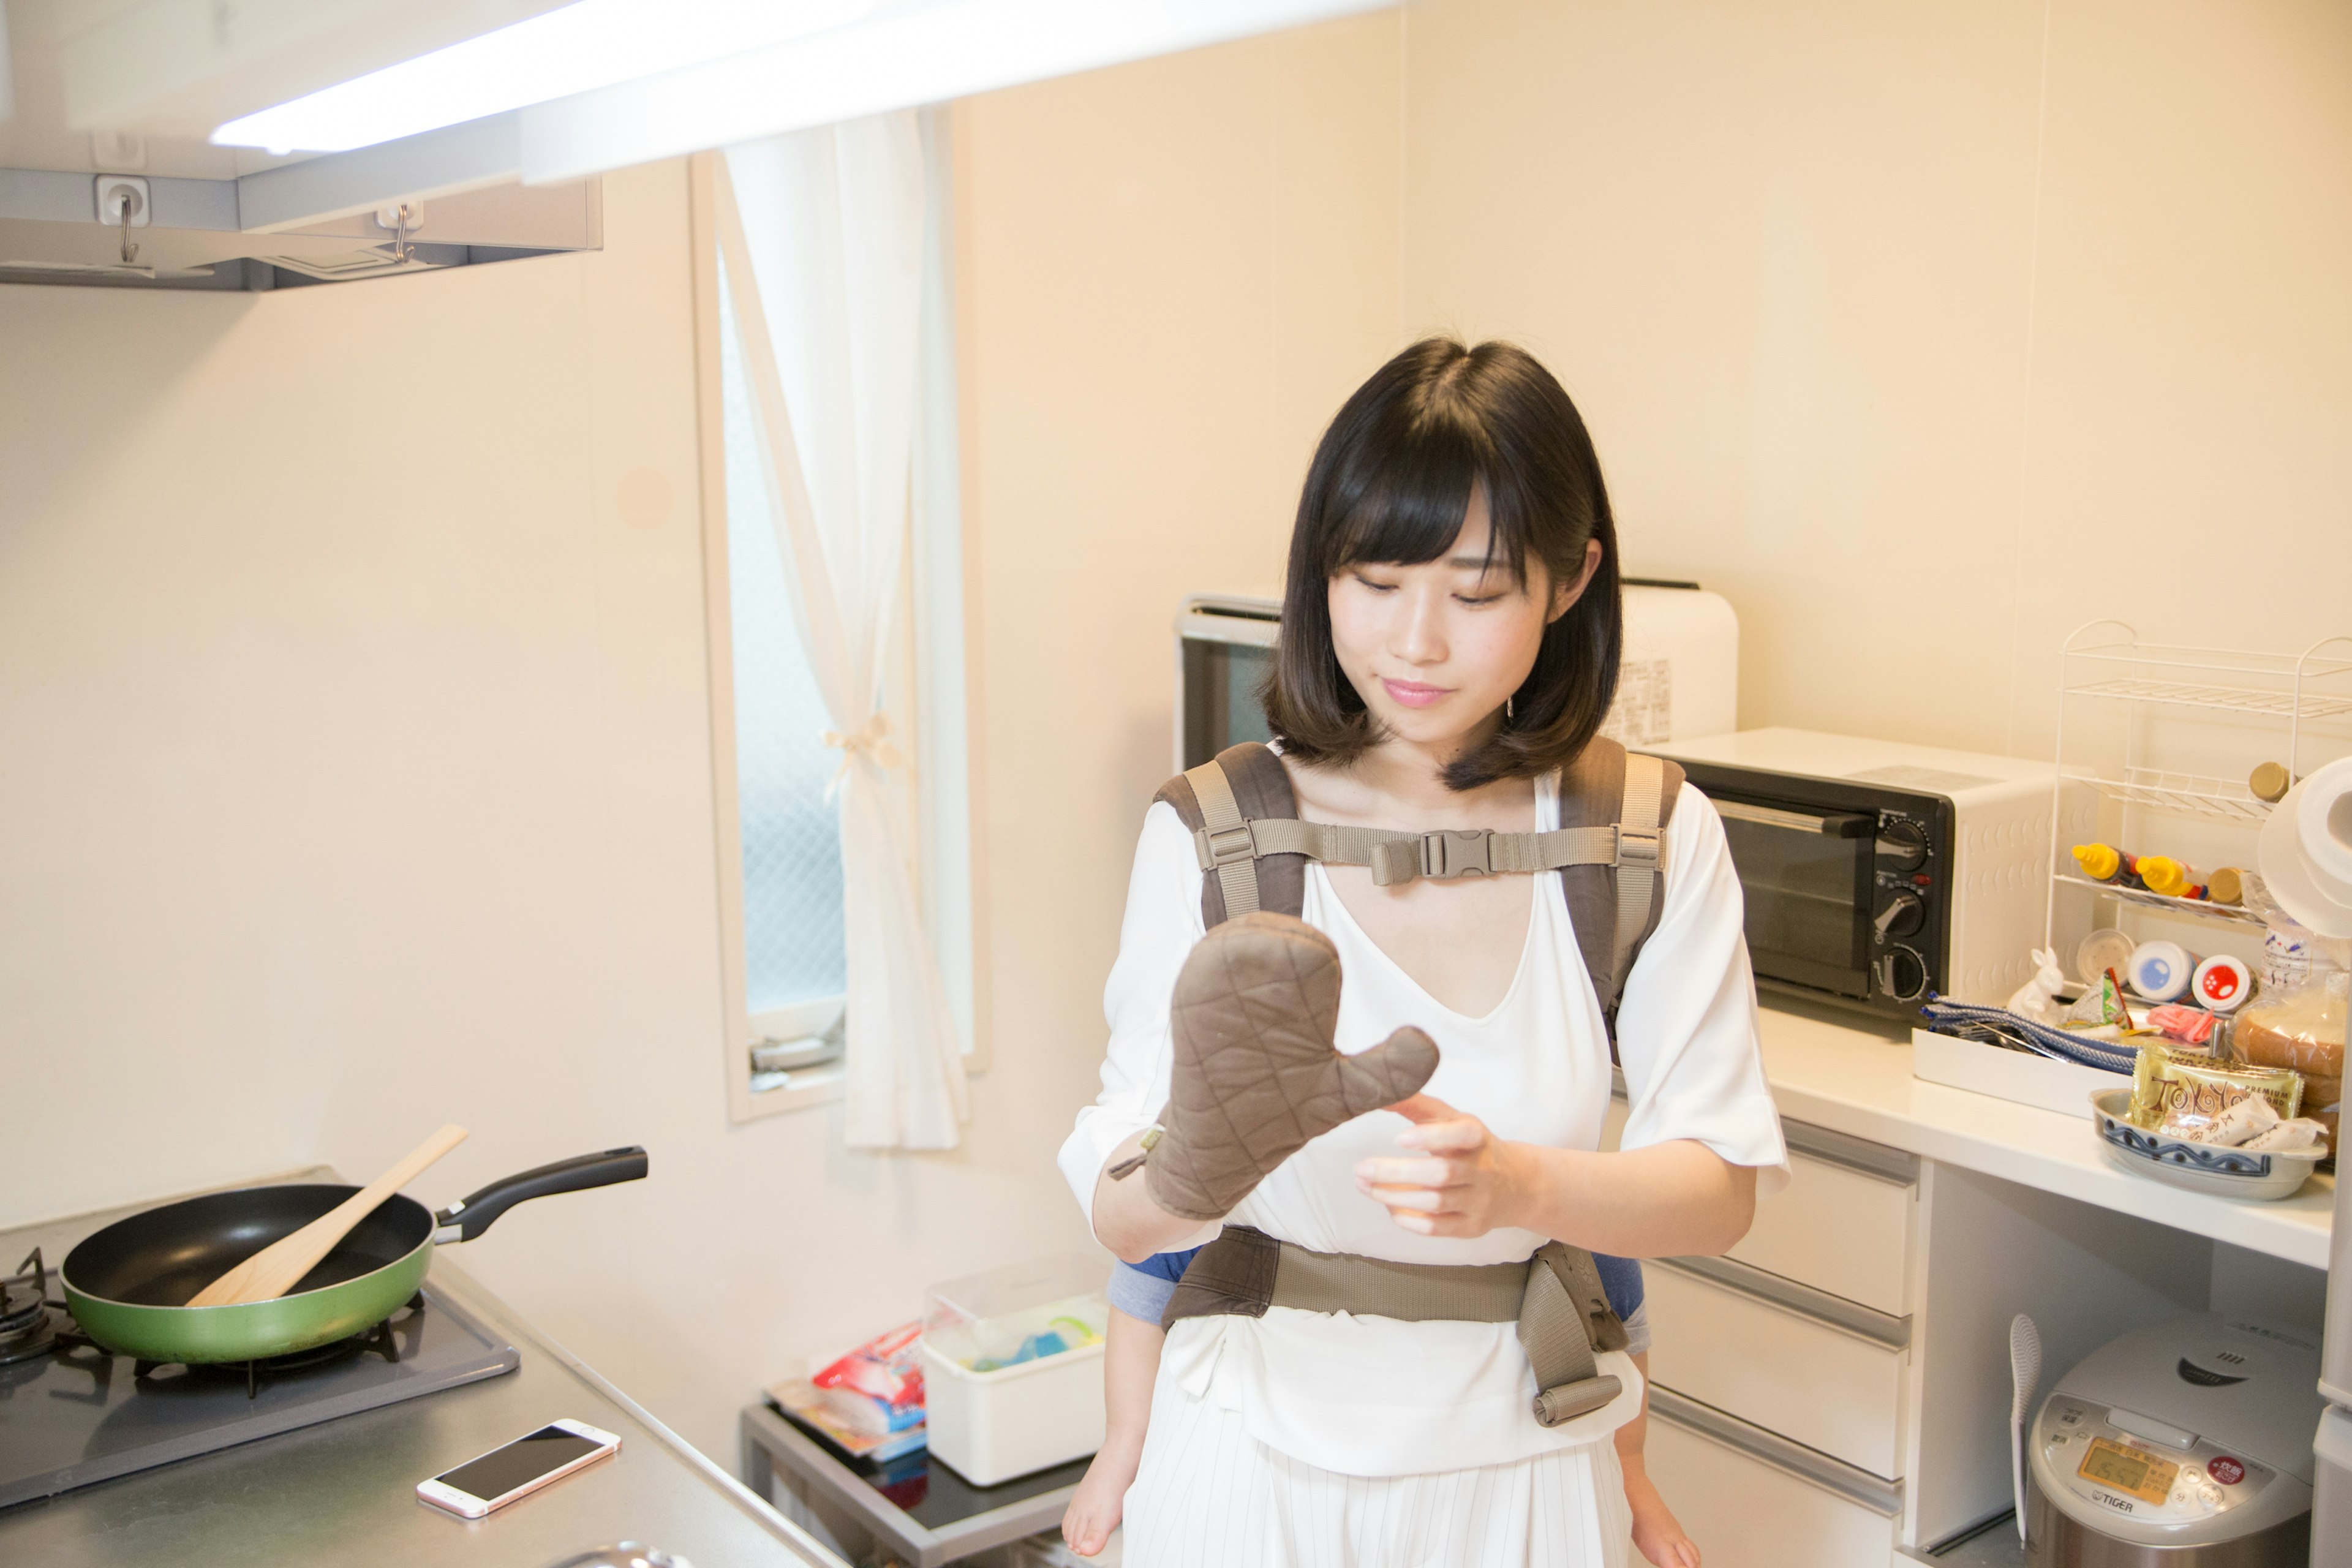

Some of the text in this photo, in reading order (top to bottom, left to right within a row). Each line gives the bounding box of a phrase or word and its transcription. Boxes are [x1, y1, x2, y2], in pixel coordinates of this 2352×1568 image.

[2148, 1076, 2242, 1115] TOKYO
[2245, 1085, 2288, 1099] PREMIUM
[2103, 1493, 2133, 1513] TIGER
